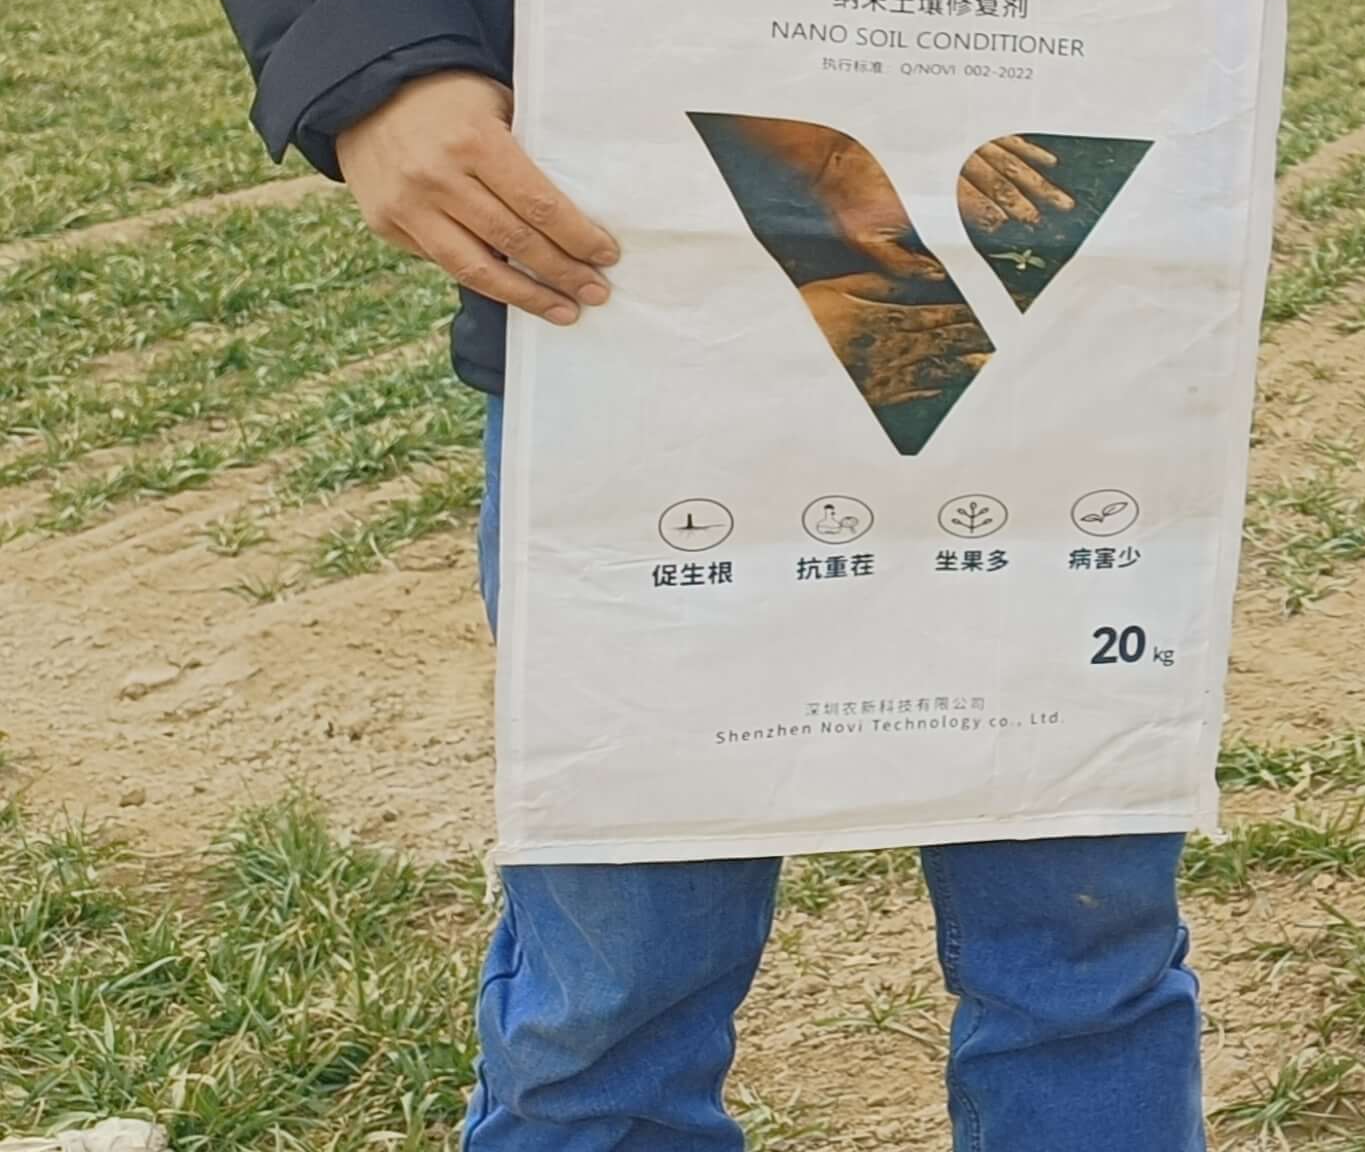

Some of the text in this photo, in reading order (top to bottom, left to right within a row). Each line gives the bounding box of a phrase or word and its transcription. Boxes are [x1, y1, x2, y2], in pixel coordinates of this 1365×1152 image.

[771, 20, 1085, 57] NANO SOIL CONDITIONER
[964, 64, 1034, 80] 002-2022
[796, 553, 876, 581] 抗重茬
[935, 549, 1010, 573] 坐果多
[1068, 546, 1142, 572] 病害少
[651, 560, 734, 588] 促生根
[1089, 624, 1175, 667] 20 kg
[804, 696, 986, 717] 深圳农新科技有限公司
[714, 723, 813, 745] Shenzhen
[820, 721, 864, 735] Novi
[872, 715, 982, 732] Technology
